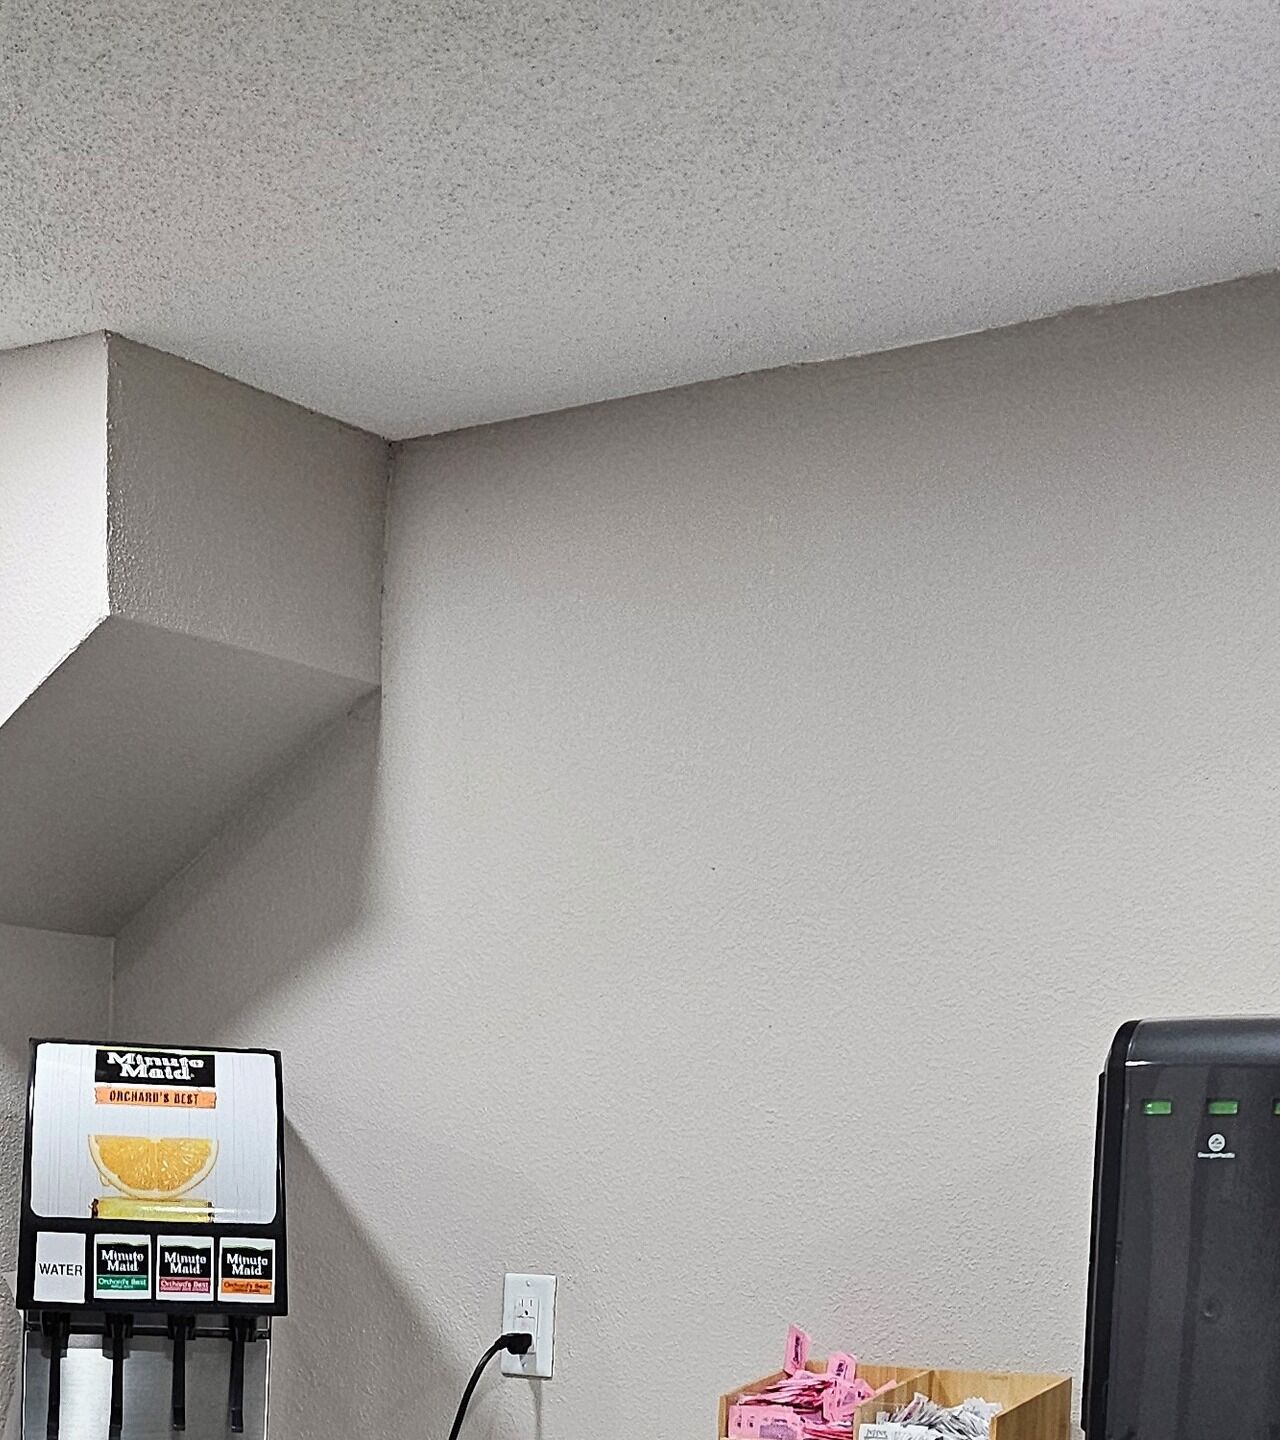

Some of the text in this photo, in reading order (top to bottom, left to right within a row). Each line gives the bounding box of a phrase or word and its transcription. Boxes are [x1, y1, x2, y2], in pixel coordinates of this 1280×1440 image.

[106, 1051, 205, 1068] Minute
[119, 1063, 191, 1080] Maid
[109, 1090, 199, 1105] ORCHARD'S BEST
[100, 1249, 145, 1262] Minute
[164, 1251, 207, 1264] Minute
[226, 1253, 269, 1266] Minute
[38, 1262, 83, 1276] WATER
[106, 1259, 139, 1272] Maid
[169, 1261, 201, 1275] Maid
[231, 1263, 263, 1276] Maid
